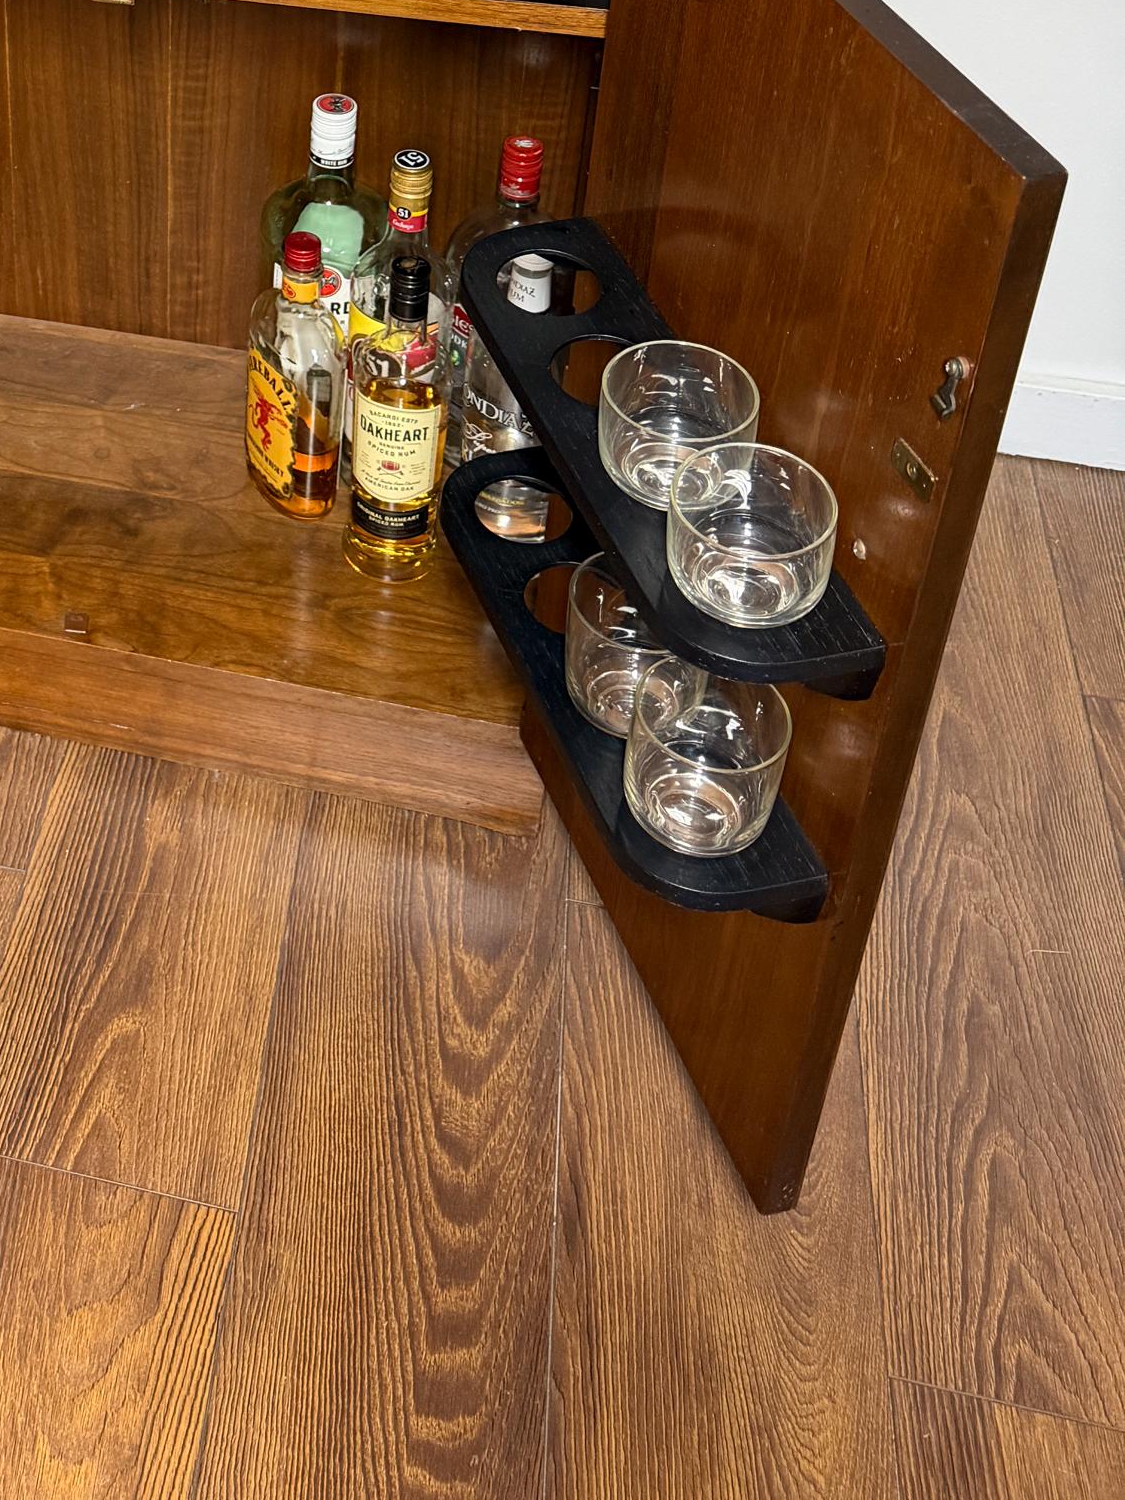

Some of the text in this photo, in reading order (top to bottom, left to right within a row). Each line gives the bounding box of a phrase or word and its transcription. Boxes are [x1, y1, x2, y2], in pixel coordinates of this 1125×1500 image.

[398, 152, 425, 166] 51
[397, 208, 409, 219] 51
[369, 409, 400, 421] BACARDI
[360, 414, 429, 442] OAKHEART
[367, 440, 416, 457] SPICED RUM
[365, 477, 399, 491] AMERICAN
[368, 515, 389, 526] SPICED
[384, 514, 420, 523] OAKHEART
